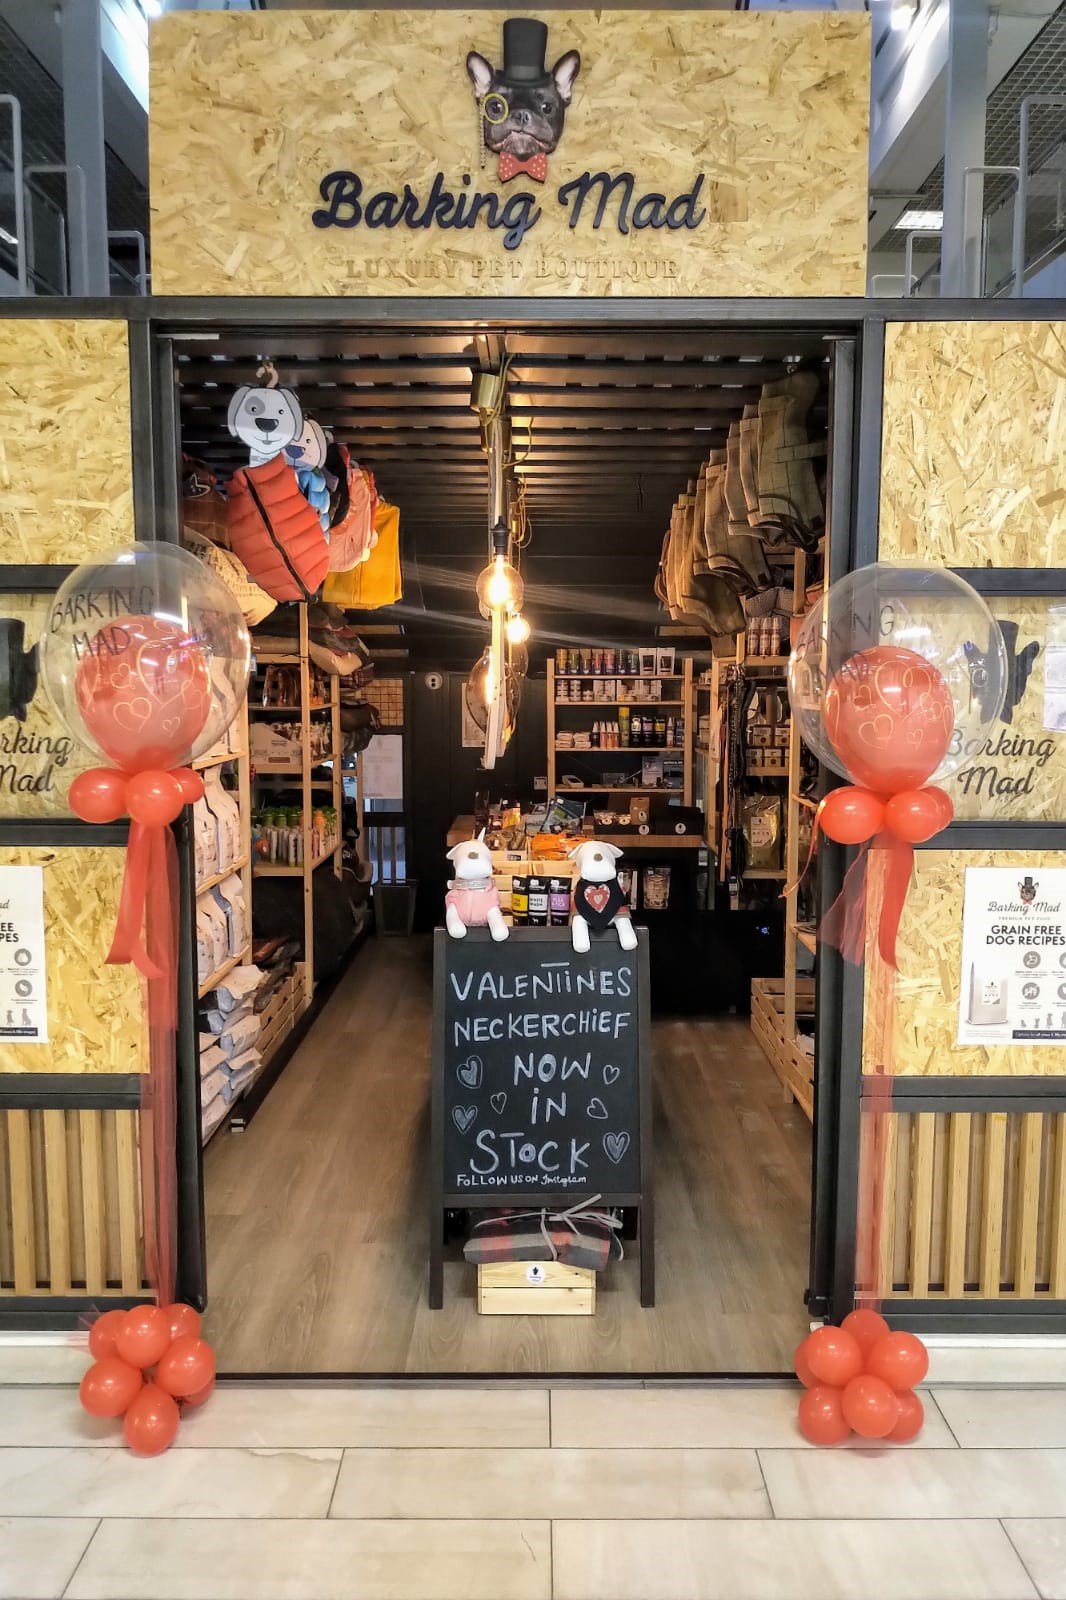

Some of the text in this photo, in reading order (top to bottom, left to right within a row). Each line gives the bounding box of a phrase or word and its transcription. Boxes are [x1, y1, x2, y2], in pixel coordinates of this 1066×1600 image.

[312, 171, 707, 251] Barking Mad
[346, 259, 678, 283] LUXURY PET BOUTIQUE
[73, 627, 131, 660] MAD
[957, 766, 1036, 798] Mad
[987, 901, 1061, 916] Barking Mad
[986, 935, 1066, 946] DOG RECIPES
[991, 925, 1062, 935] GRAIN FREE
[513, 1052, 592, 1086] NOW
[469, 1129, 591, 1175] STOCK
[510, 1174, 523, 1184] US
[524, 1174, 539, 1184] ON
